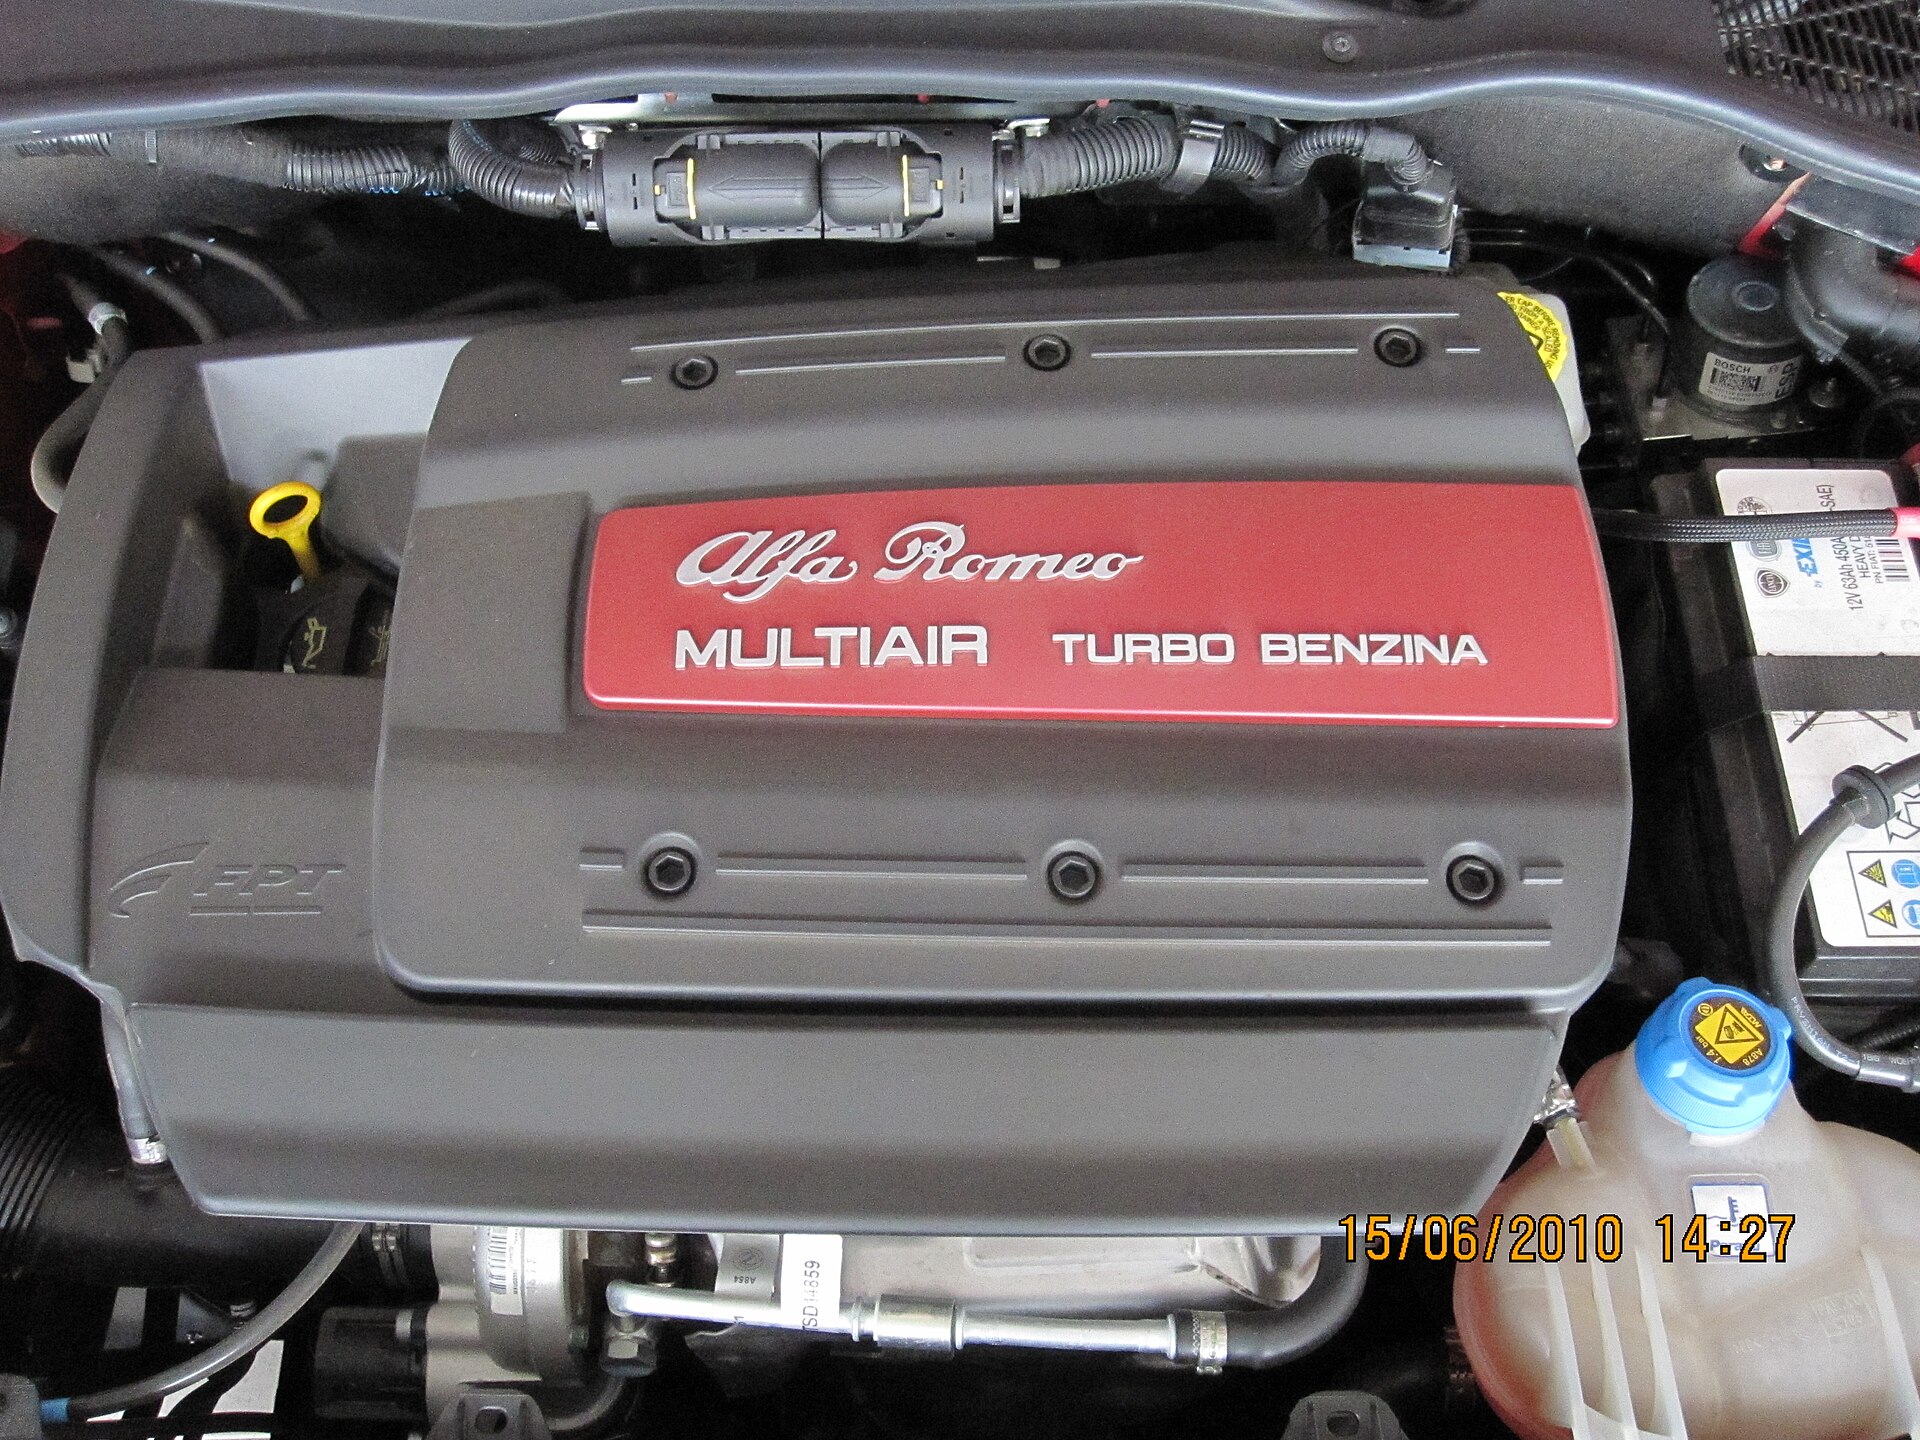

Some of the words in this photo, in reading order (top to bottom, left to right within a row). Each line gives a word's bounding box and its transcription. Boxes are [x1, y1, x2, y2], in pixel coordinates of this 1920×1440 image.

[1519, 305, 1539, 320] FROM
[1533, 305, 1556, 328] BEFORE
[1714, 358, 1752, 374] BOSCH
[1774, 361, 1799, 399] ESP
[674, 529, 859, 602] Alfa
[873, 521, 1145, 583] Romeo
[1852, 542, 1872, 579] HEAVY
[1837, 563, 1859, 590] 63Ah
[1874, 572, 1884, 584] PN
[1845, 591, 1864, 611] 12V
[674, 625, 989, 669] MULTIAIR
[1052, 633, 1236, 666] TURBO
[1260, 633, 1489, 667] BENZINA
[1696, 1035, 1709, 1048] bar
[1706, 1048, 1722, 1064] 1.4
